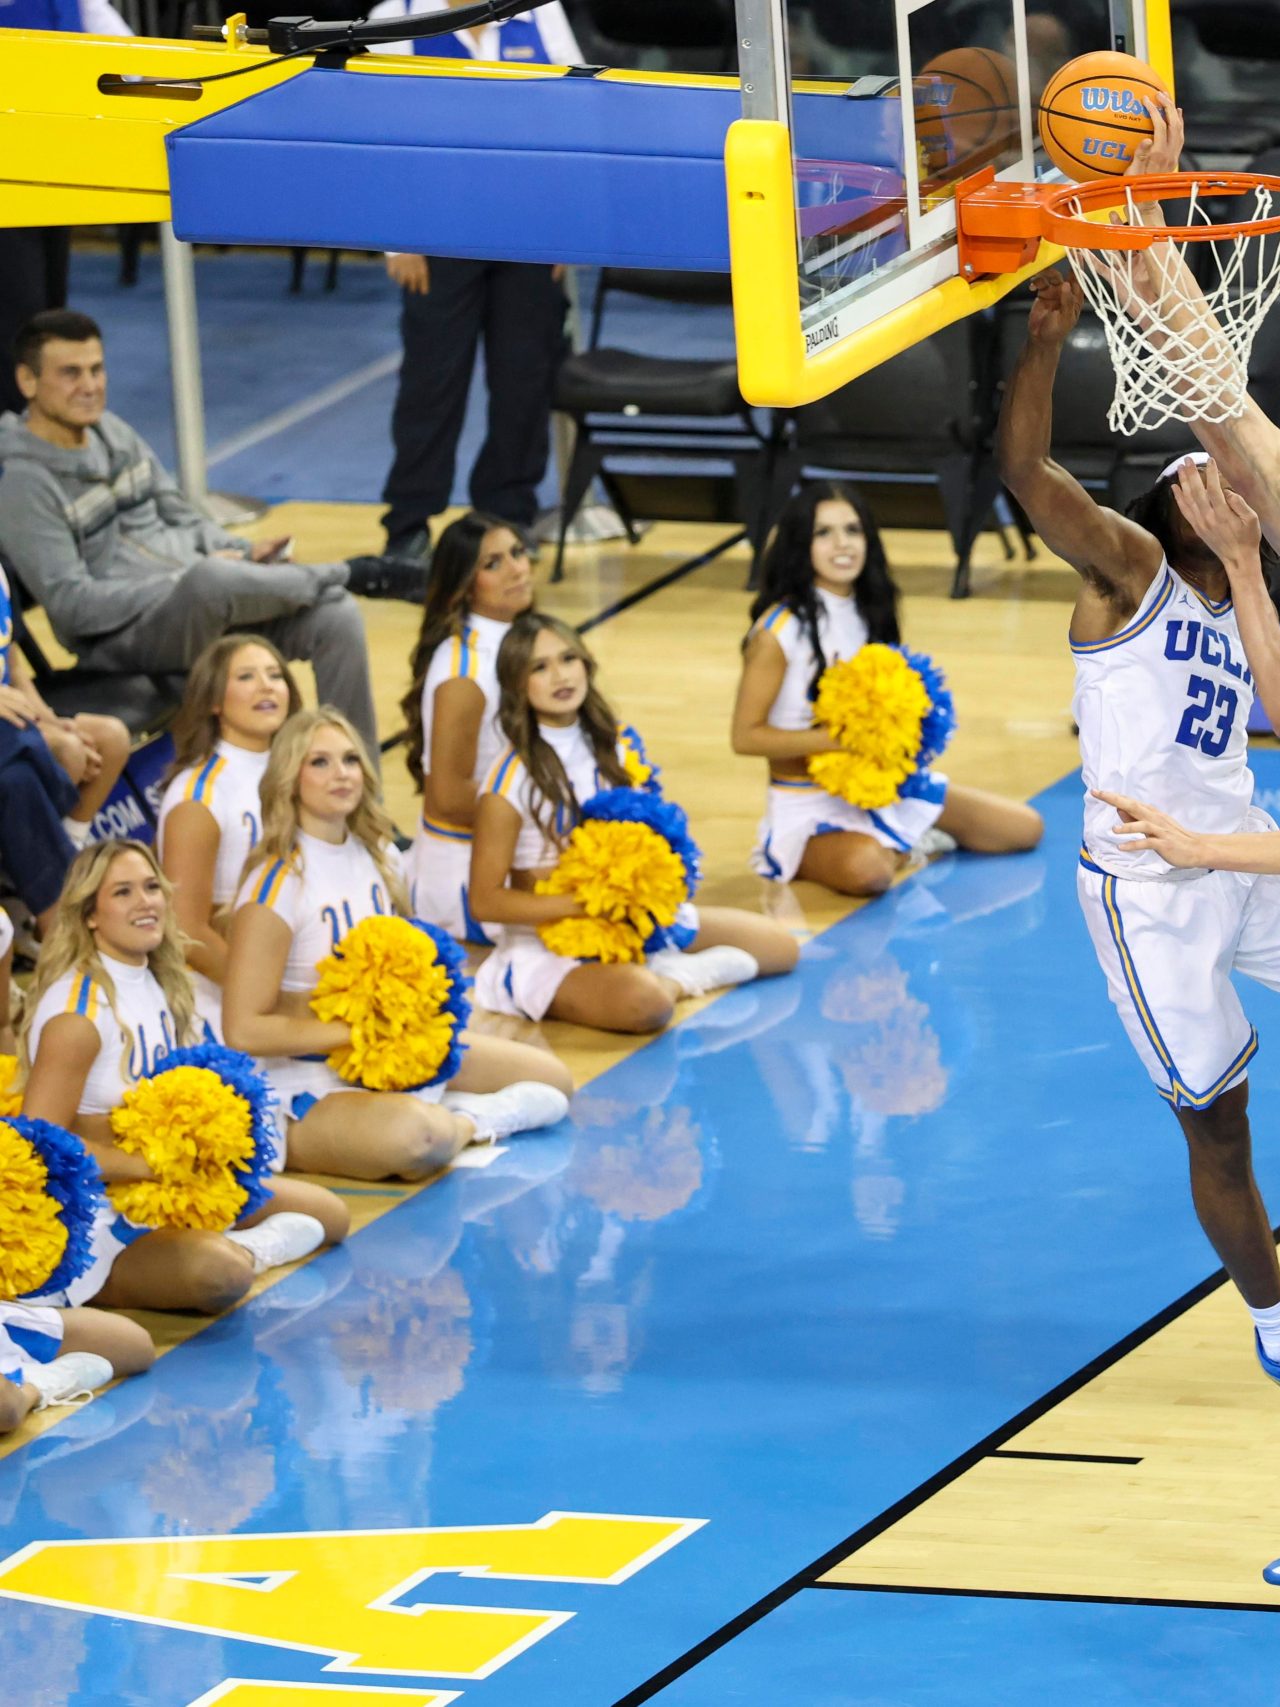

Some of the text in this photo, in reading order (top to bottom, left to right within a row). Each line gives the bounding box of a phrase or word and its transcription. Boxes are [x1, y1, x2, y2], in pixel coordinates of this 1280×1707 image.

[1081, 87, 1153, 119] Wils
[1082, 138, 1133, 161] UCL
[805, 316, 839, 353] PALDING
[1175, 674, 1238, 757] 23
